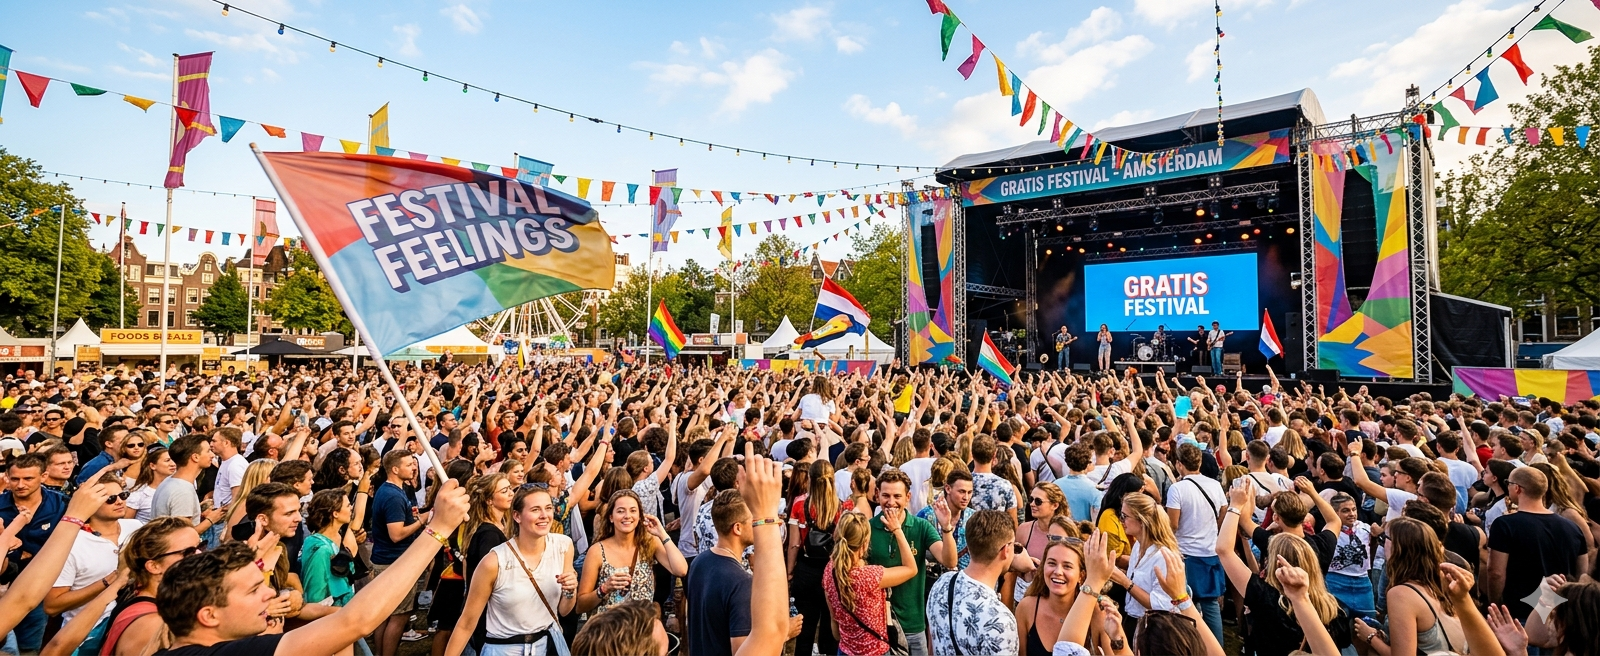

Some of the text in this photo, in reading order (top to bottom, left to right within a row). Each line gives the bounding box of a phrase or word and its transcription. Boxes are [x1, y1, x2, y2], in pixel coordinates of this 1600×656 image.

[1000, 176, 1045, 197] GRATIS
[1047, 166, 1110, 190] FESTIVAL
[347, 179, 562, 244] FESTIVAL
[373, 217, 575, 290] FEELINGS
[1123, 271, 1209, 298] GRATIS
[1124, 296, 1210, 316] FESTIVAL
[110, 332, 150, 340] FOODS
